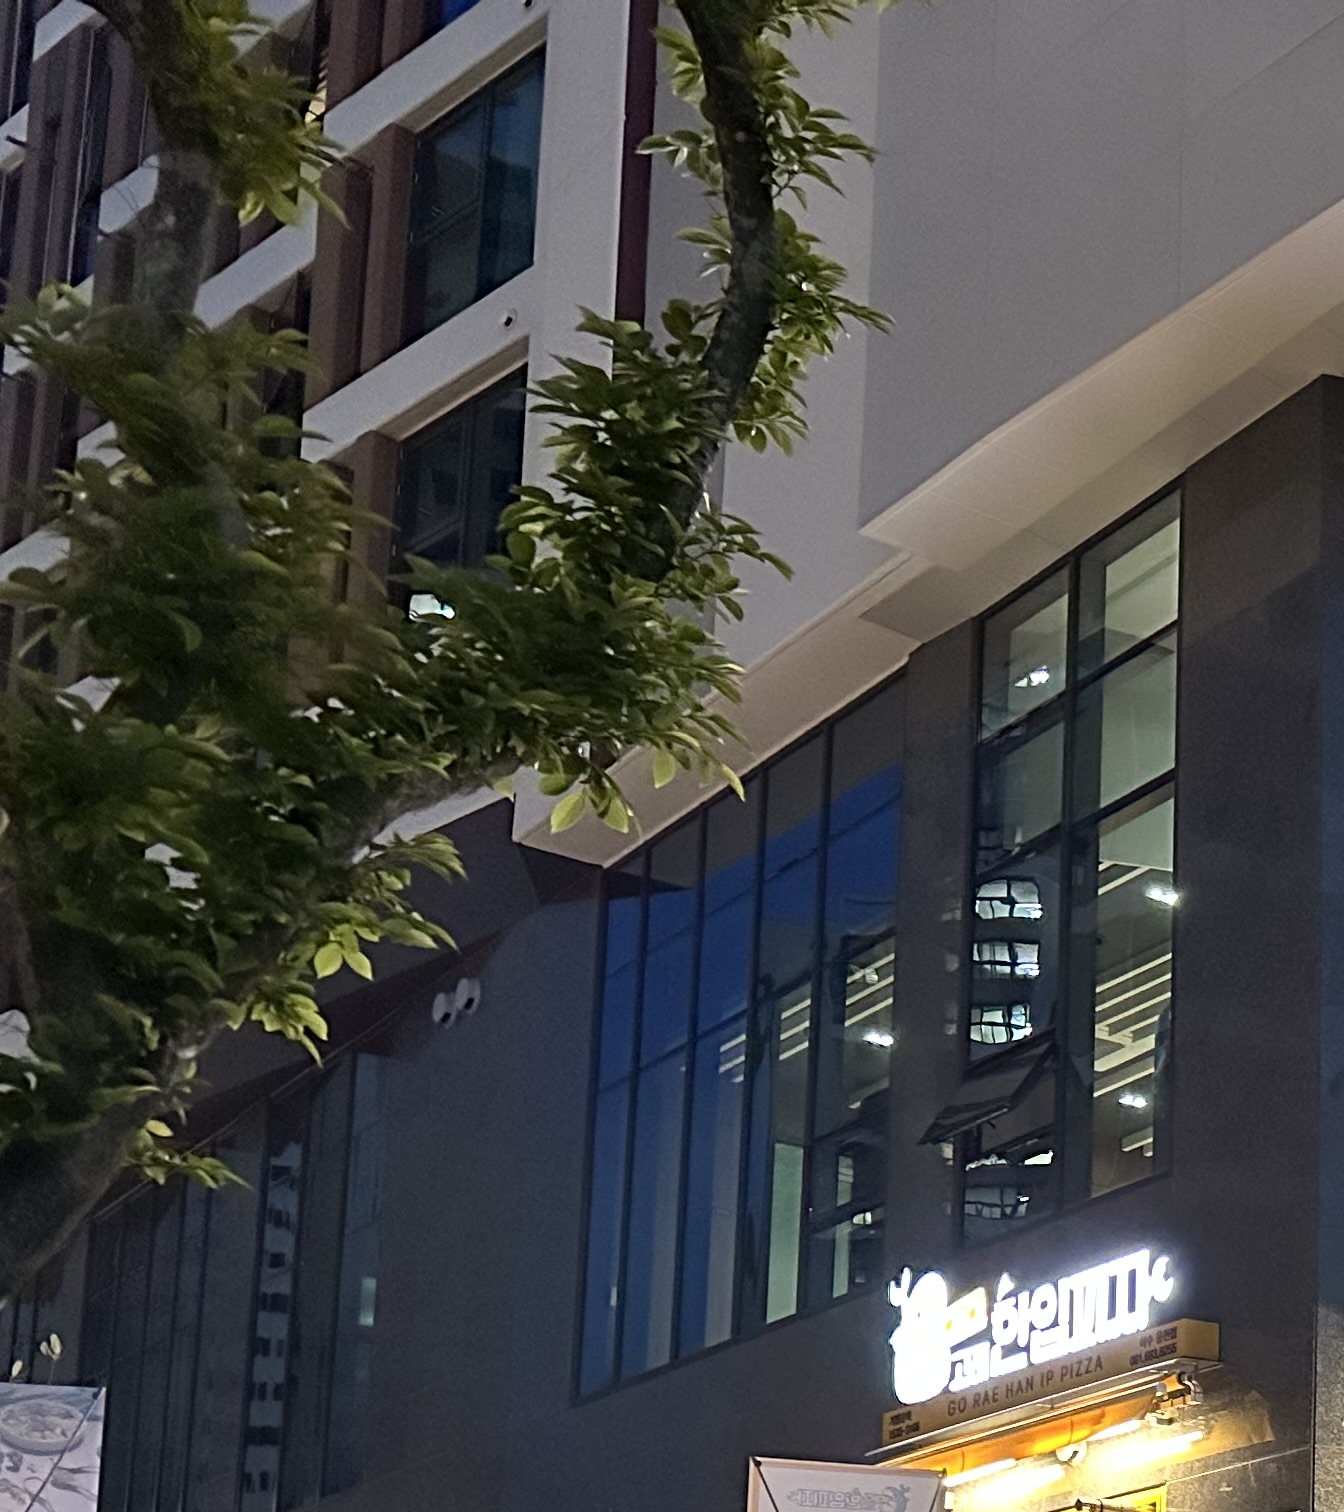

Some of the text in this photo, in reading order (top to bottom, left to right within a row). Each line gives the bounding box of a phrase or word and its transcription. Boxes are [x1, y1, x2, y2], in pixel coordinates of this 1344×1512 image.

[947, 1354, 1105, 1417] GO RAE HAN IP PIZZA
